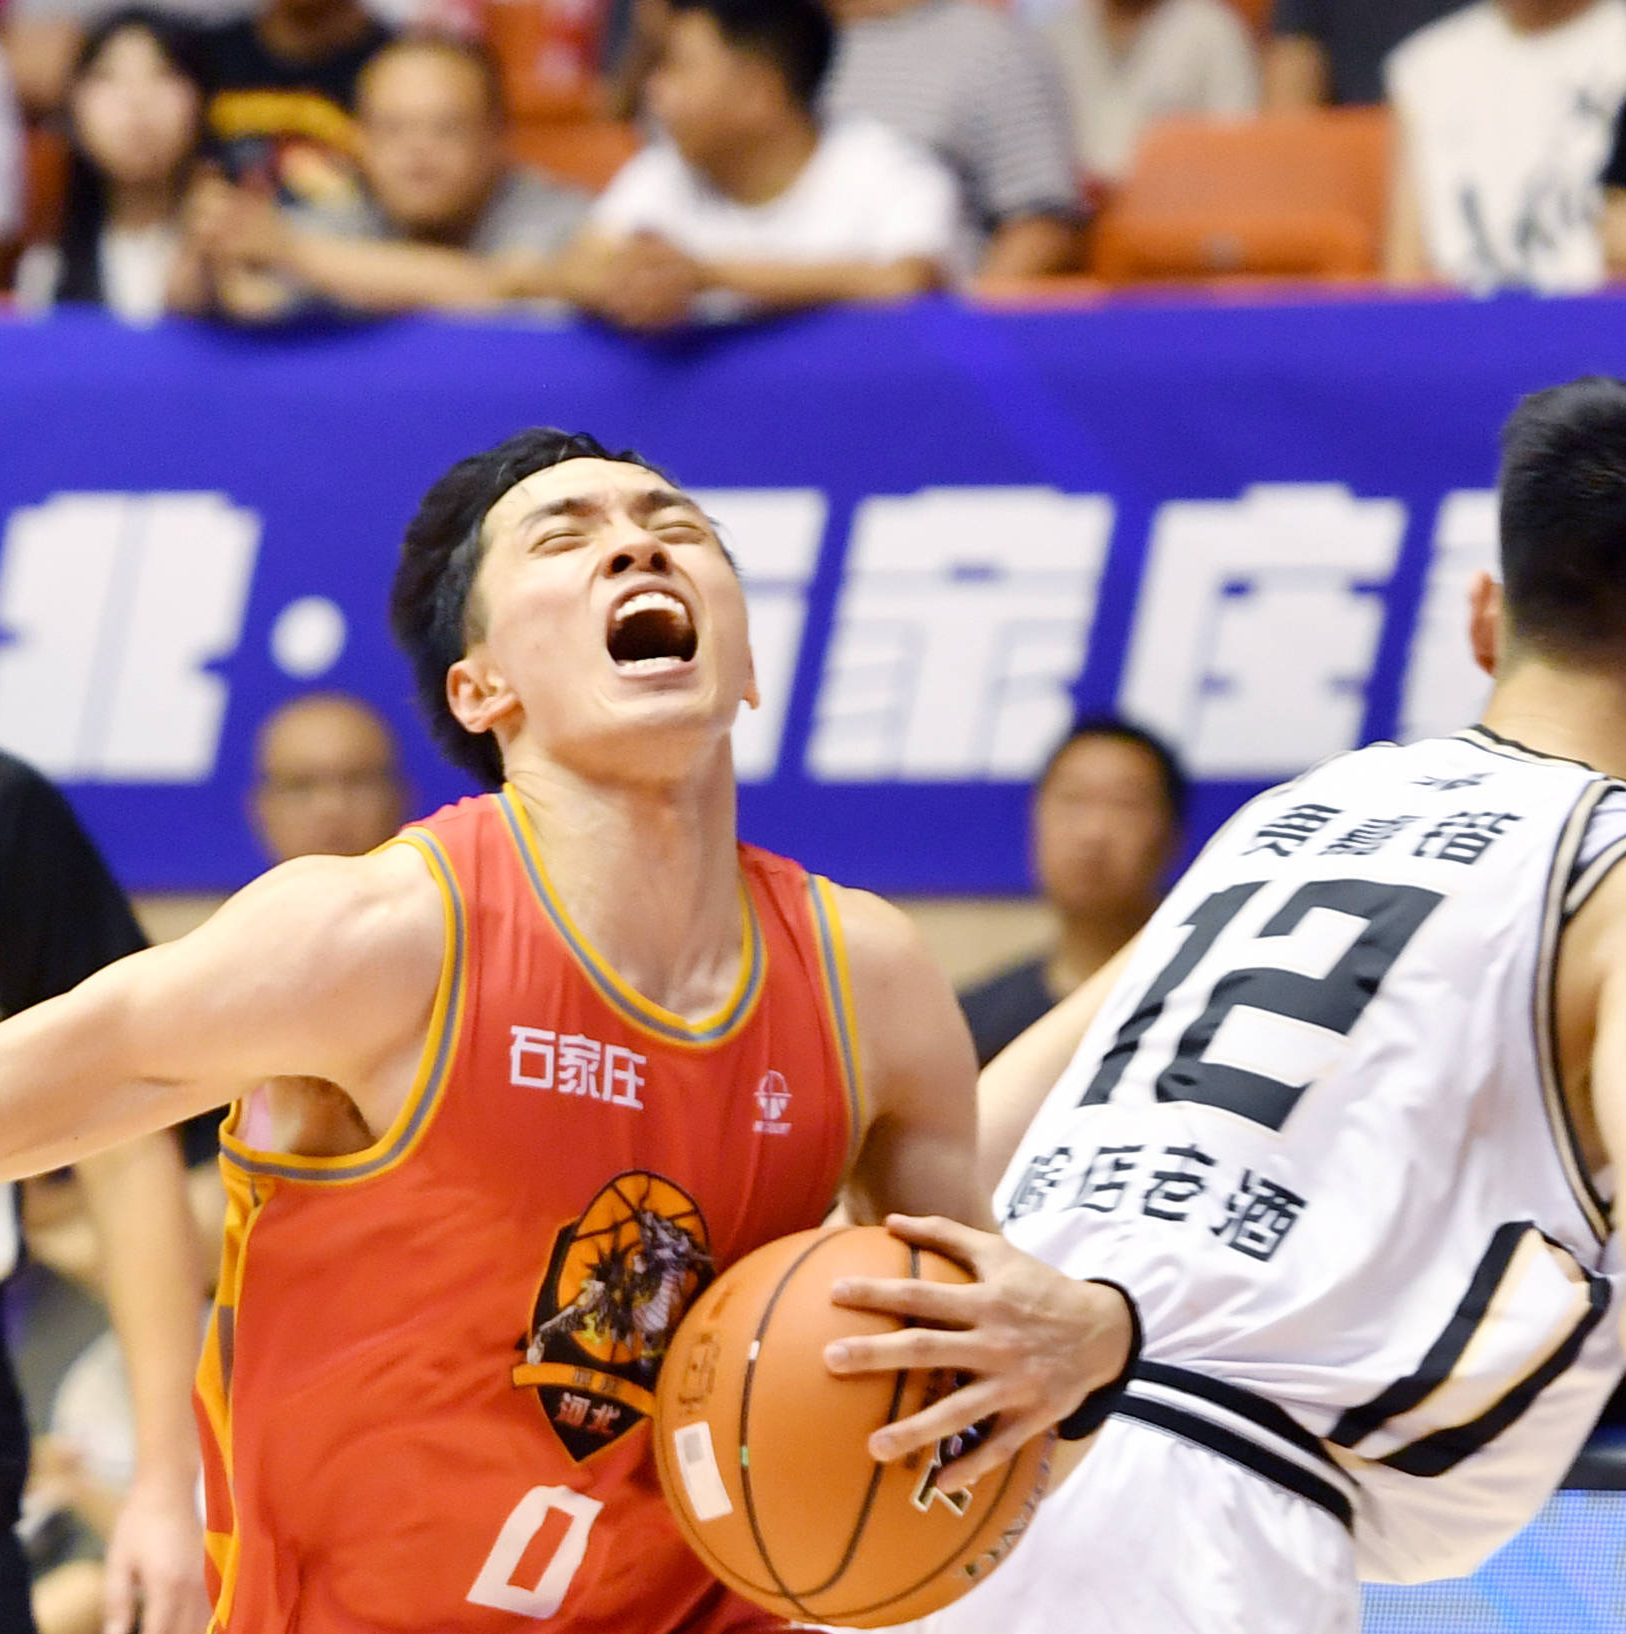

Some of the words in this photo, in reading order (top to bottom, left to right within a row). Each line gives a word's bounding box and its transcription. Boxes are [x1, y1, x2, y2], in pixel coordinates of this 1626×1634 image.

[508, 1024, 647, 1111] 石家庄
[1075, 878, 1448, 1133] 12
[465, 1484, 605, 1619] 0
